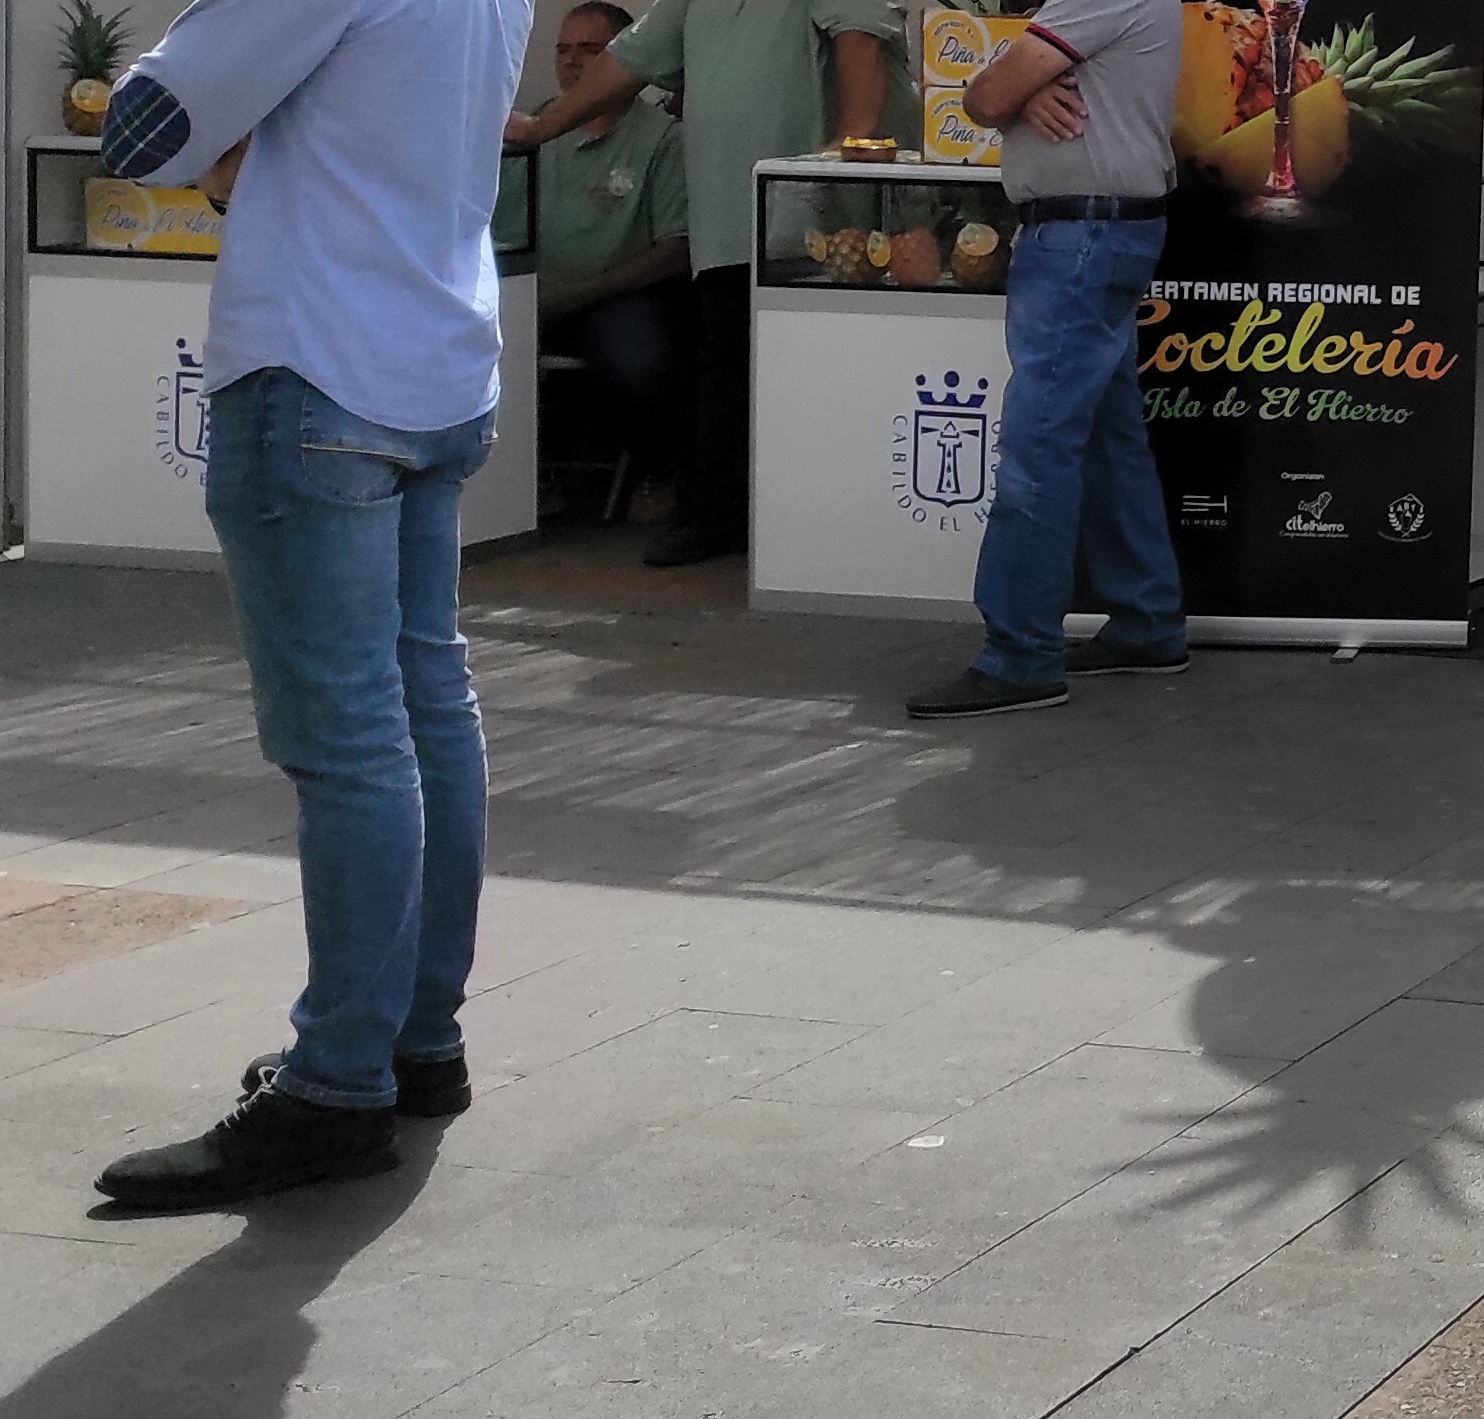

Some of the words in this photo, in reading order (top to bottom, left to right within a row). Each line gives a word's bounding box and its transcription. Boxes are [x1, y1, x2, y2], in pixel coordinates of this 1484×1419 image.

[937, 35, 975, 65] Piña
[936, 114, 975, 143] Piña
[1143, 280, 1260, 302] ERTAMEN
[1267, 282, 1383, 305] REGIONAL
[1390, 285, 1422, 306] DE
[1140, 385, 1207, 424] Isla
[1212, 386, 1251, 419] de
[1258, 385, 1301, 422] El
[1306, 387, 1415, 425] Hierro
[155, 375, 188, 479] CABILDO
[892, 414, 927, 524] CABILDO
[939, 515, 961, 532] EL
